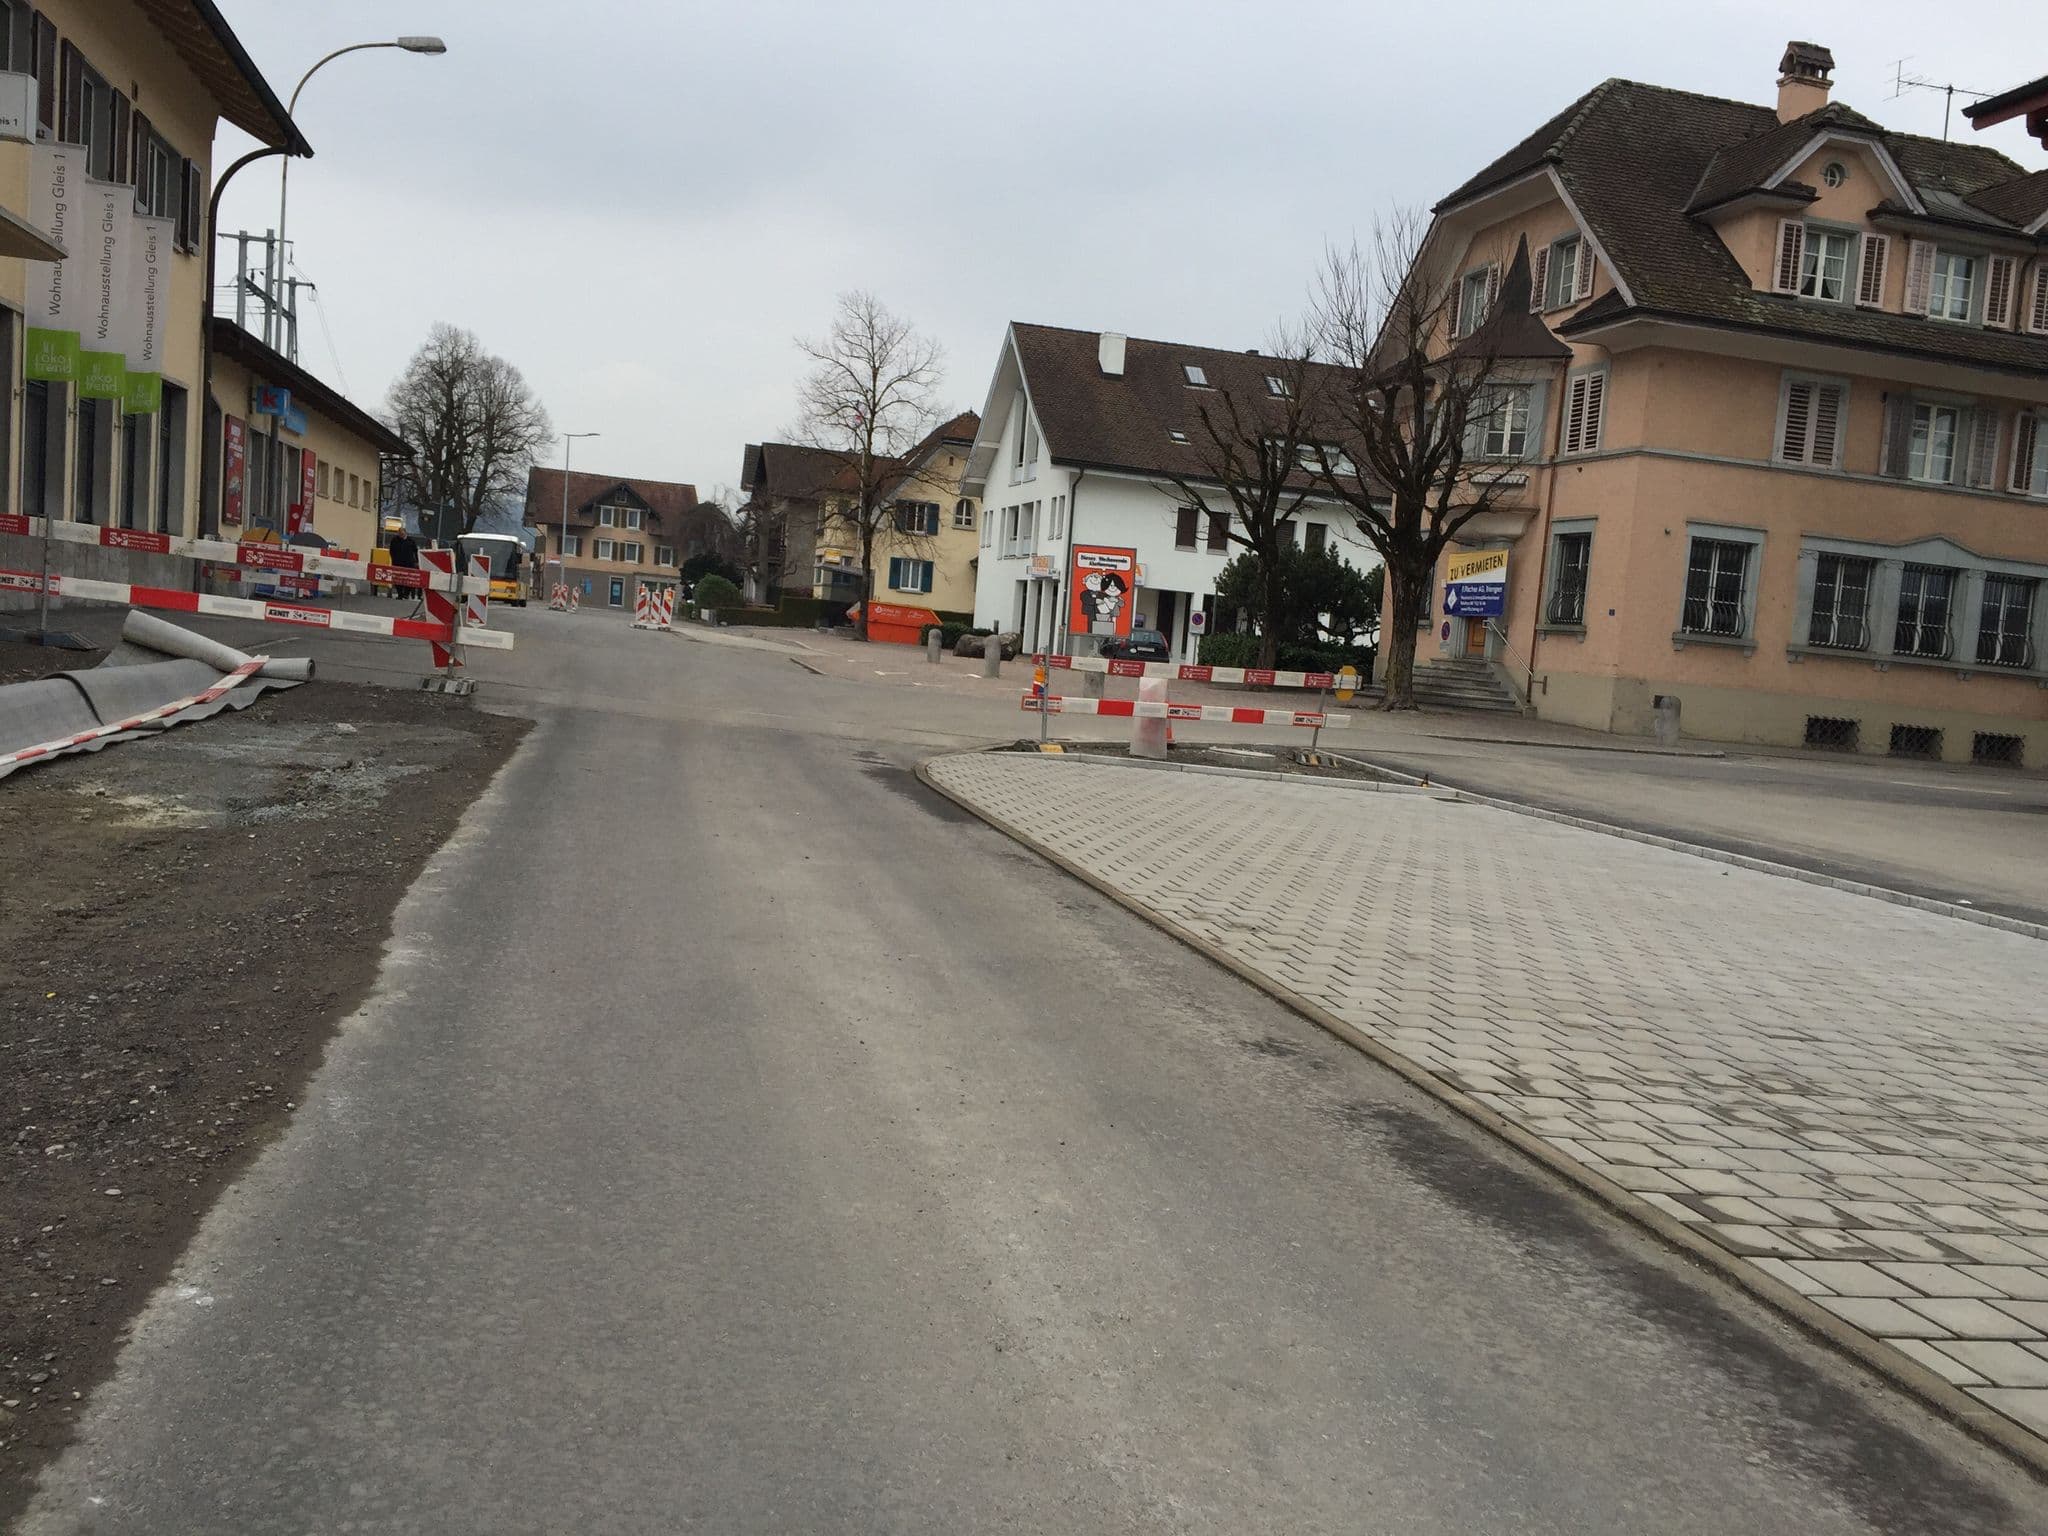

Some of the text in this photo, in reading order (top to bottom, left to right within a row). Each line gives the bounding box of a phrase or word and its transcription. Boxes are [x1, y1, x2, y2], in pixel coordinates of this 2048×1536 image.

[52, 165, 66, 198] Gleis
[102, 202, 114, 233] Gleis
[145, 235, 157, 263] Gleis
[98, 236, 116, 339] Wohnausstellung
[144, 265, 158, 361] Wohnausstellung
[1450, 553, 1504, 581] ZU VERMIETEN
